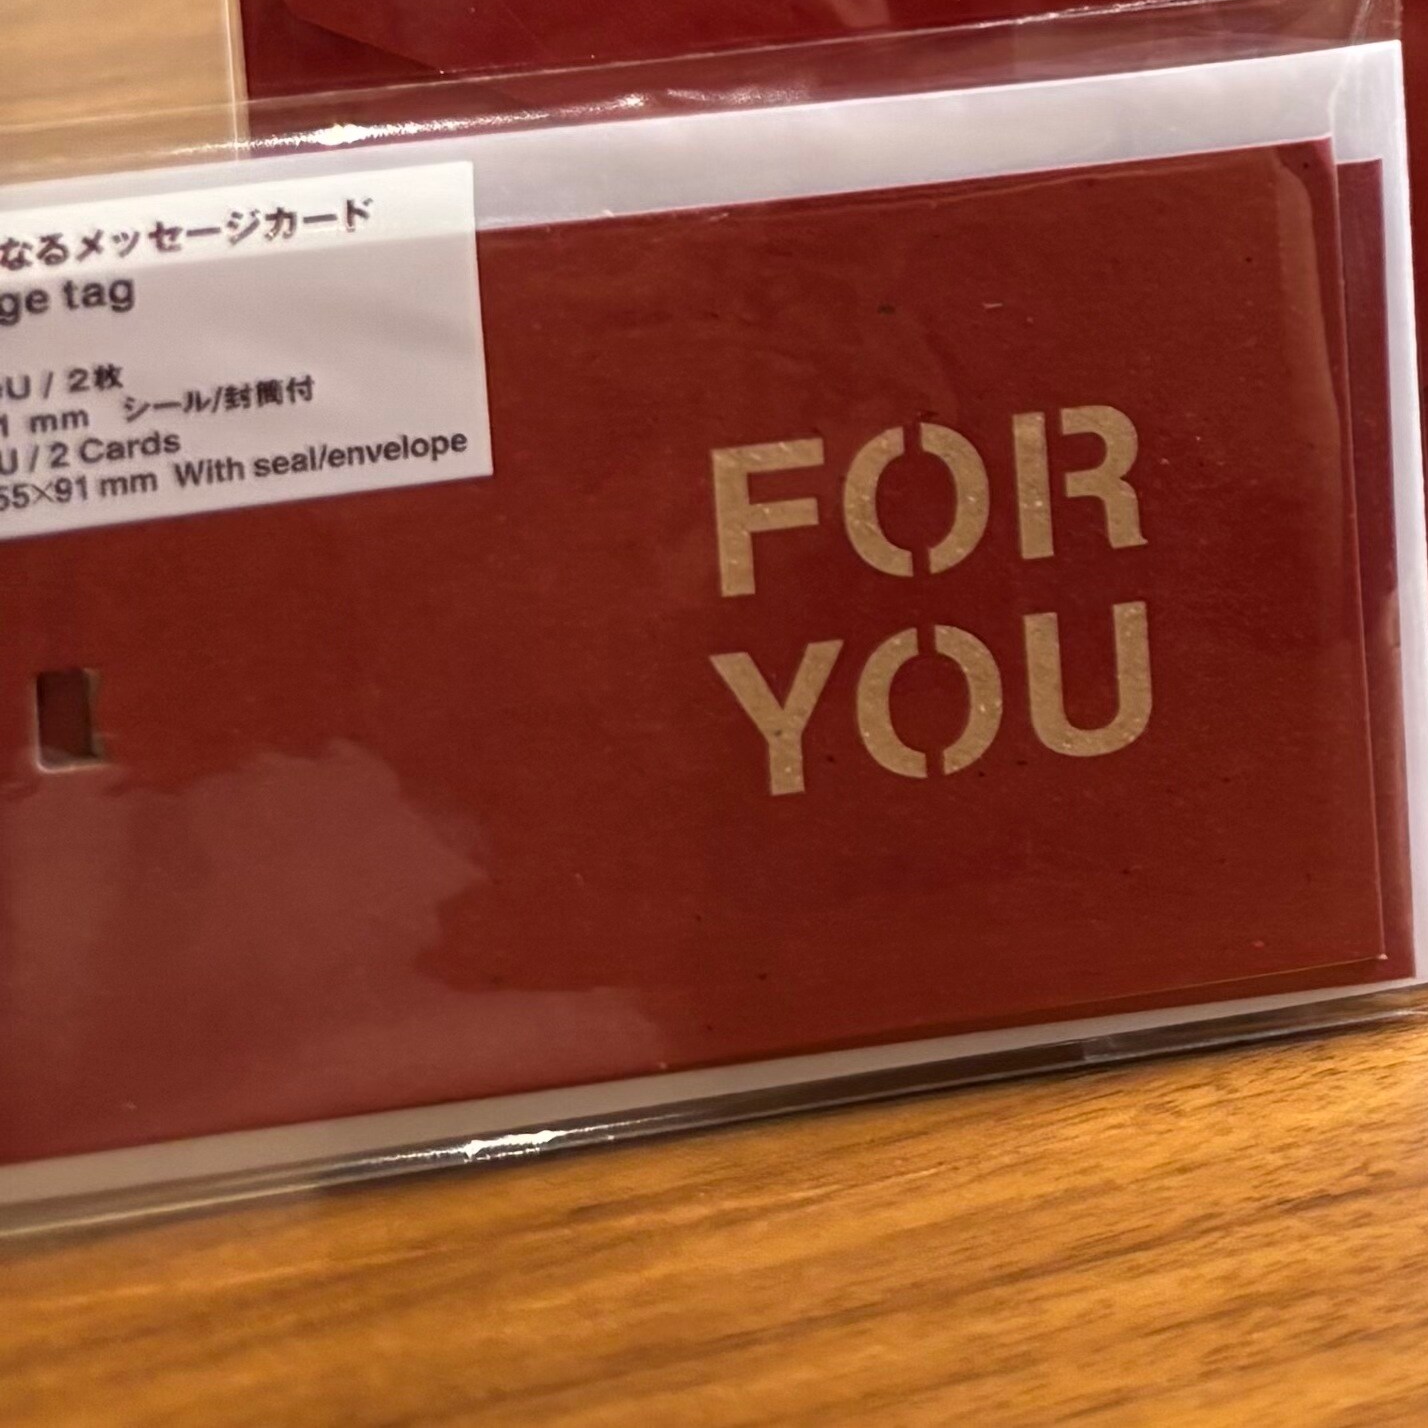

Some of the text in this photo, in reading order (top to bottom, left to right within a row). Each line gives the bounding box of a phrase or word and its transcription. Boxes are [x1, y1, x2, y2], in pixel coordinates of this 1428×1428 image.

[0, 197, 374, 271] なるメッセージカード
[64, 278, 134, 312] tag
[30, 409, 89, 435] mm
[122, 375, 315, 423] シール/封筒付
[68, 364, 123, 394] 2枚
[49, 443, 70, 470] 2
[79, 431, 181, 465] Cards
[100, 470, 158, 499] mm
[175, 456, 246, 488] With
[254, 430, 468, 481] seal/envelope
[711, 405, 1148, 597] FOR
[709, 601, 1153, 796] YOU
